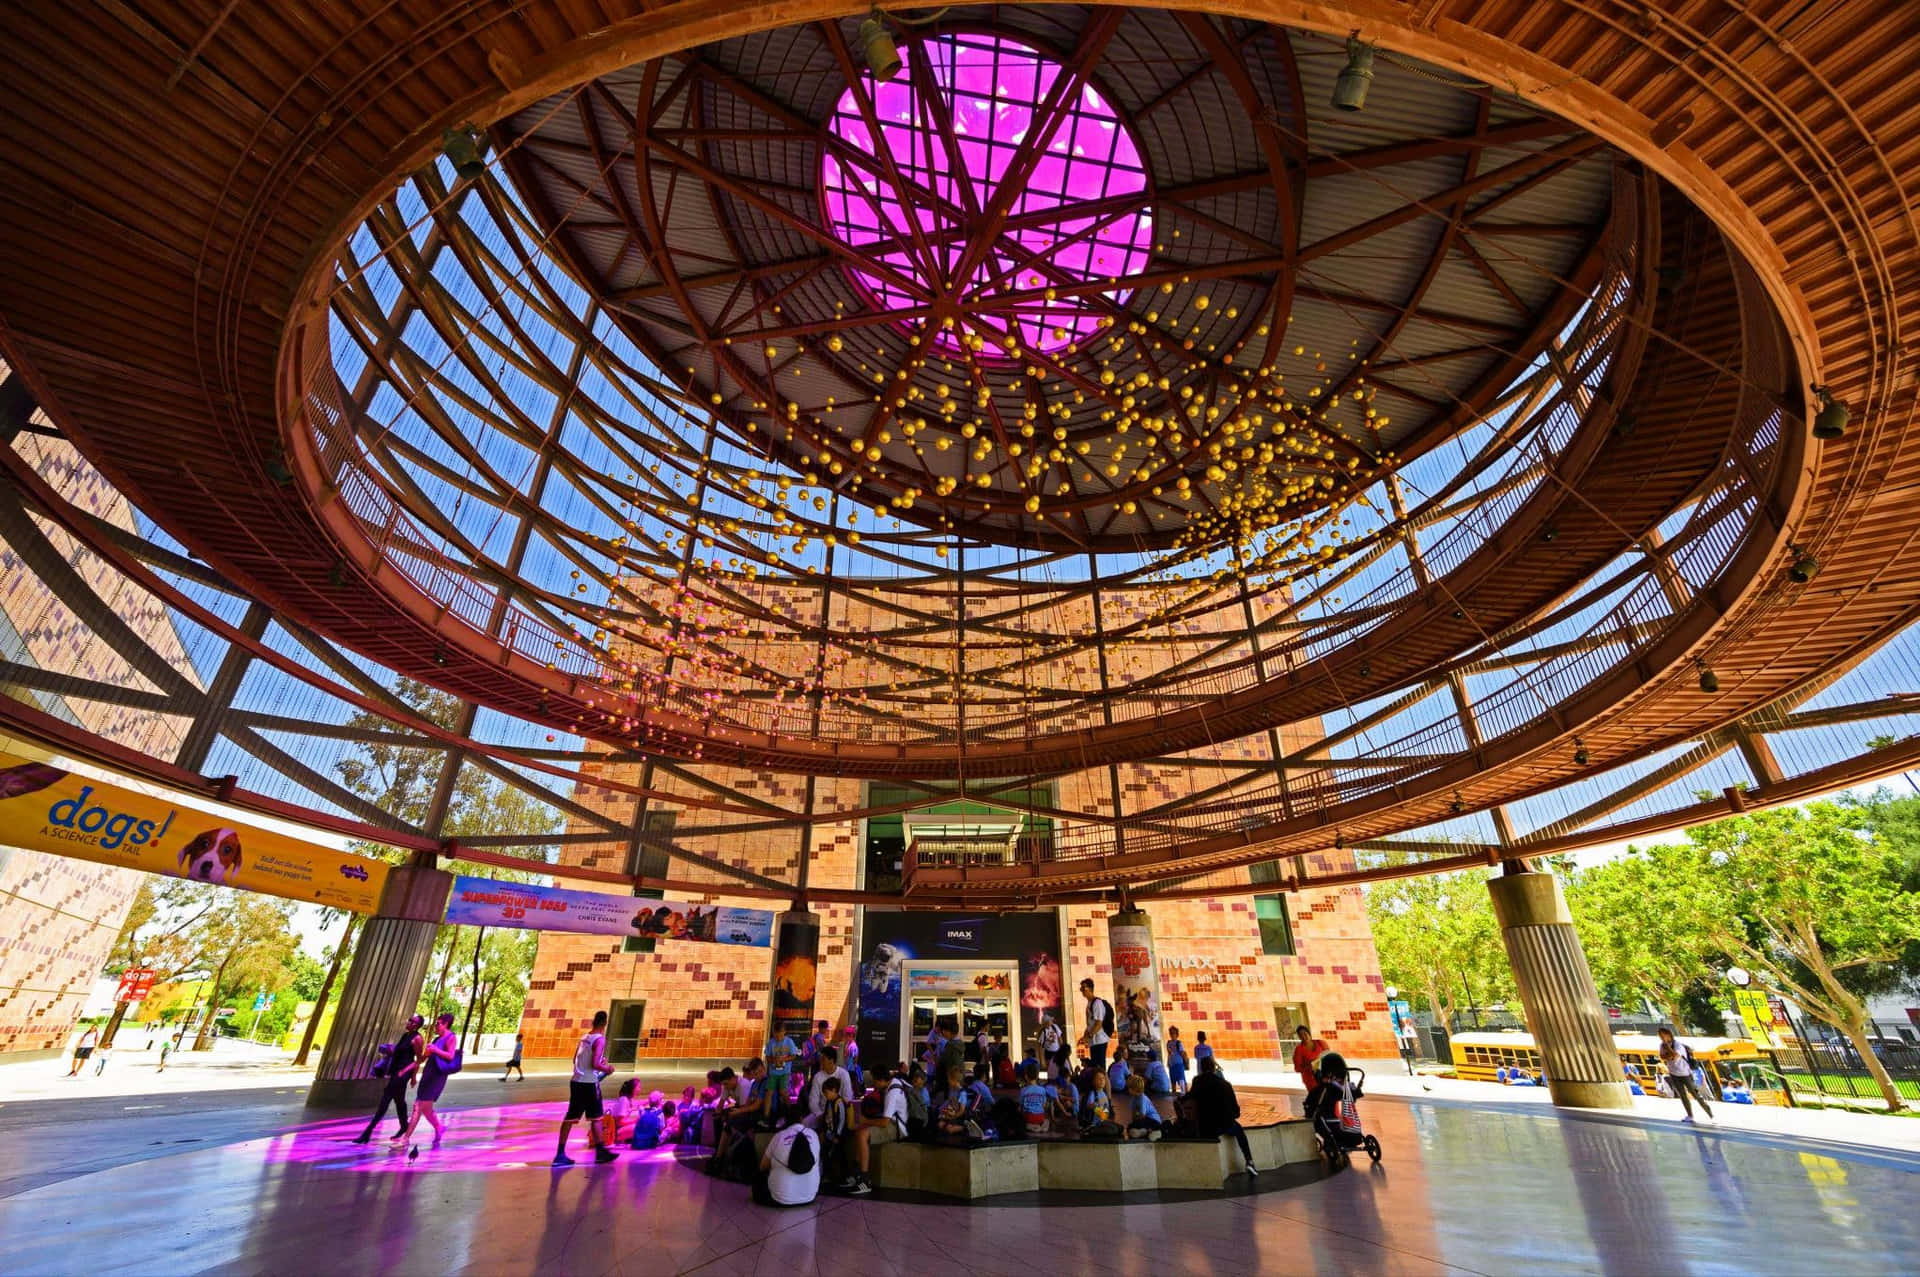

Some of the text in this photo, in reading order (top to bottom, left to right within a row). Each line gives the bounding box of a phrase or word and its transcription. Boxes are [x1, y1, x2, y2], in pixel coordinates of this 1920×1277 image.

[48, 784, 176, 850] dogs!
[39, 826, 99, 846] A SCIENCE
[122, 843, 142, 857] TAIL
[461, 890, 539, 909] SUPERPOWER
[501, 906, 526, 919] 3D
[597, 916, 618, 924] EVANS
[947, 930, 973, 938] IMAX
[1161, 956, 1217, 971] IMAX
